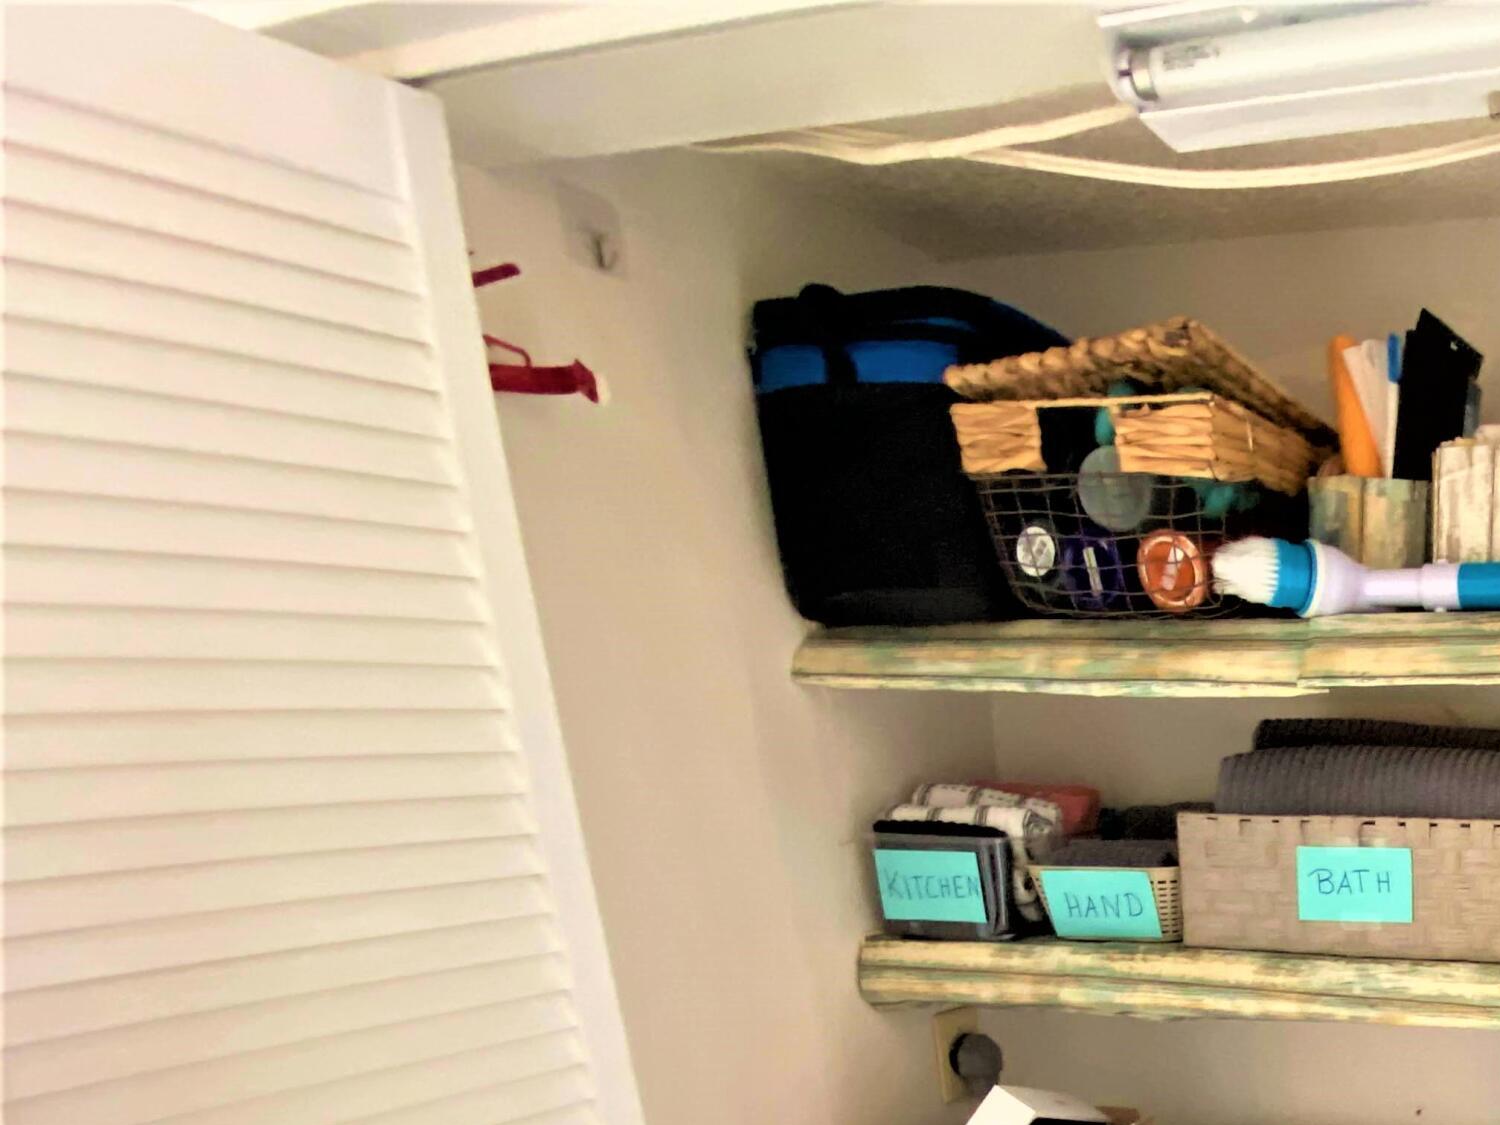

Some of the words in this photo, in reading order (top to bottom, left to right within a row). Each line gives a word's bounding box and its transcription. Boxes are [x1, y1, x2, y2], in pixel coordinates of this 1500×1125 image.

[884, 868, 980, 900] KITCHEN
[1307, 868, 1391, 895] BATH
[1064, 892, 1144, 918] HAND
